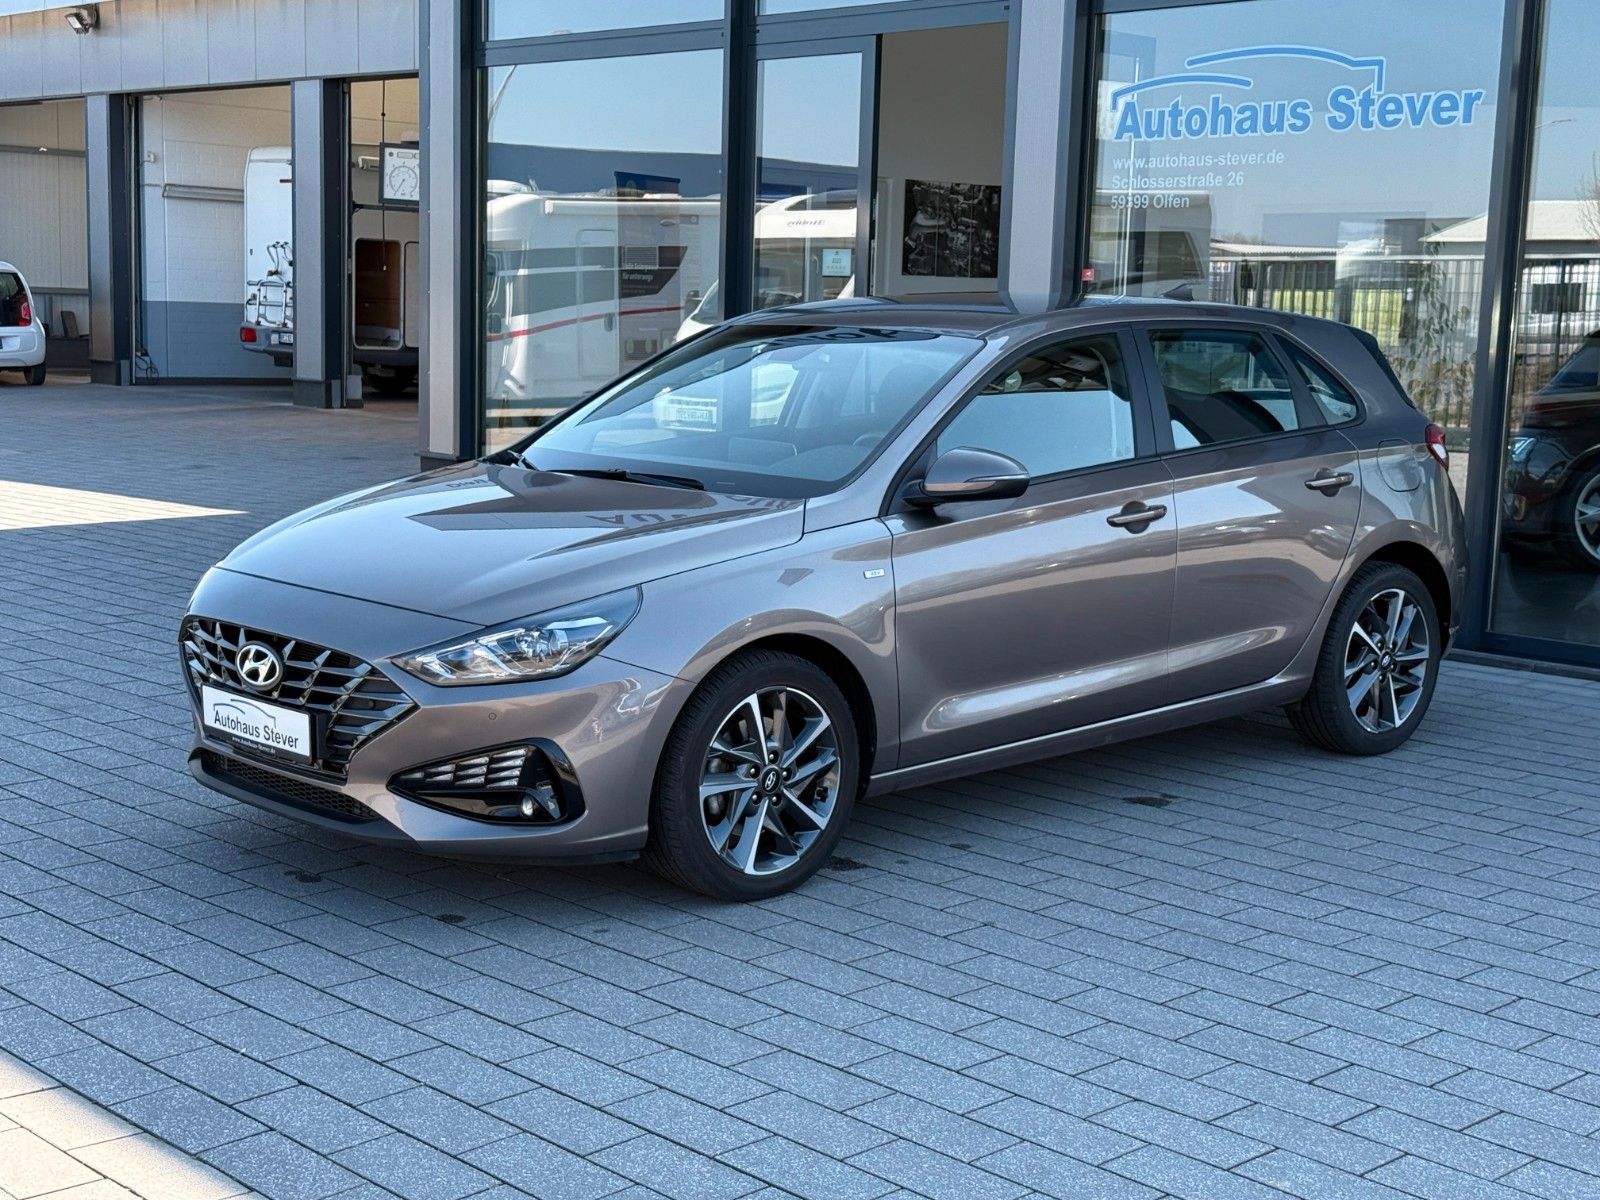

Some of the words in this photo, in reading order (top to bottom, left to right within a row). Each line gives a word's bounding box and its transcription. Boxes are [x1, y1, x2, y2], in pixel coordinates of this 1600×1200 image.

[1113, 93, 1311, 142] Autohaus
[1326, 84, 1485, 132] Stever
[1113, 150, 1285, 170] www.autohaus-stever.de
[1112, 172, 1223, 190] Schlosserstraße
[1227, 171, 1245, 187] 26
[1110, 194, 1150, 210] 59399
[1153, 193, 1190, 209] Olfen
[214, 710, 260, 738] Autohaus
[263, 725, 299, 749] Stever
